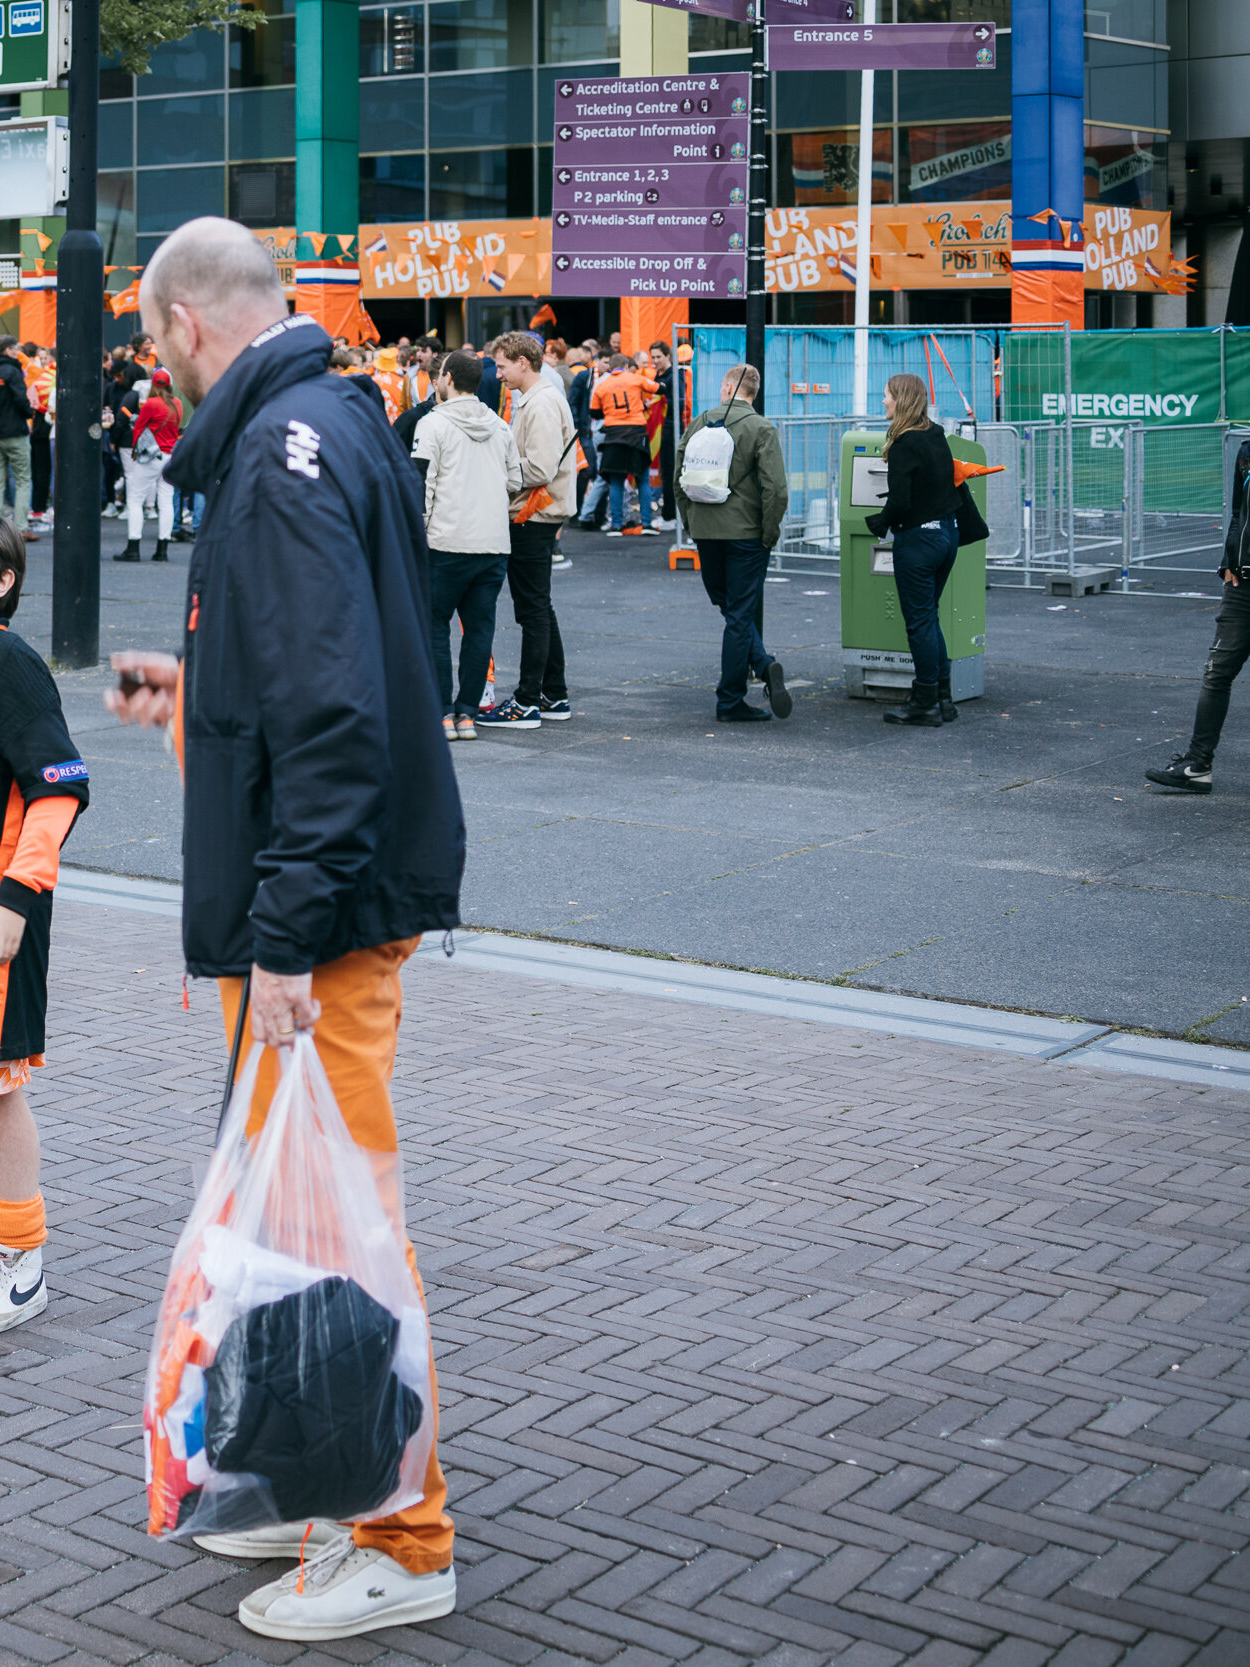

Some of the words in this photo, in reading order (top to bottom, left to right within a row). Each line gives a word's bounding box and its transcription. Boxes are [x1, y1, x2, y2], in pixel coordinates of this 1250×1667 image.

[793, 30, 859, 42] Entrance
[863, 29, 873, 41] 5
[576, 80, 659, 96] Accreditation
[663, 79, 706, 92] Centre
[709, 78, 720, 90] &
[576, 102, 632, 117] Ticketing
[635, 101, 678, 114] Centre
[575, 126, 636, 141] Spectator
[640, 123, 716, 137] Information
[673, 144, 708, 157] Point
[918, 141, 1005, 183] CHAMPIONS
[574, 169, 630, 183] Entrance
[596, 190, 643, 205] parking
[573, 213, 655, 225] TV-Media-Staff
[657, 214, 707, 225] entrance
[766, 207, 810, 239] UB
[1095, 207, 1132, 239] PUB
[407, 222, 461, 253] PUB
[1082, 223, 1159, 273] OLLAND
[572, 257, 636, 270] Accessible
[639, 257, 670, 272] Drop
[674, 257, 693, 270] Off
[697, 257, 707, 270] &
[416, 269, 471, 298] PUB
[1102, 259, 1138, 291] PUB
[630, 278, 656, 291] Pick
[660, 279, 678, 293] Up
[681, 279, 715, 292] Point
[612, 390, 631, 414] 4
[1042, 393, 1199, 417] EMERGENCY
[1090, 427, 1125, 449] EX
[58, 764, 88, 778] RESPE
